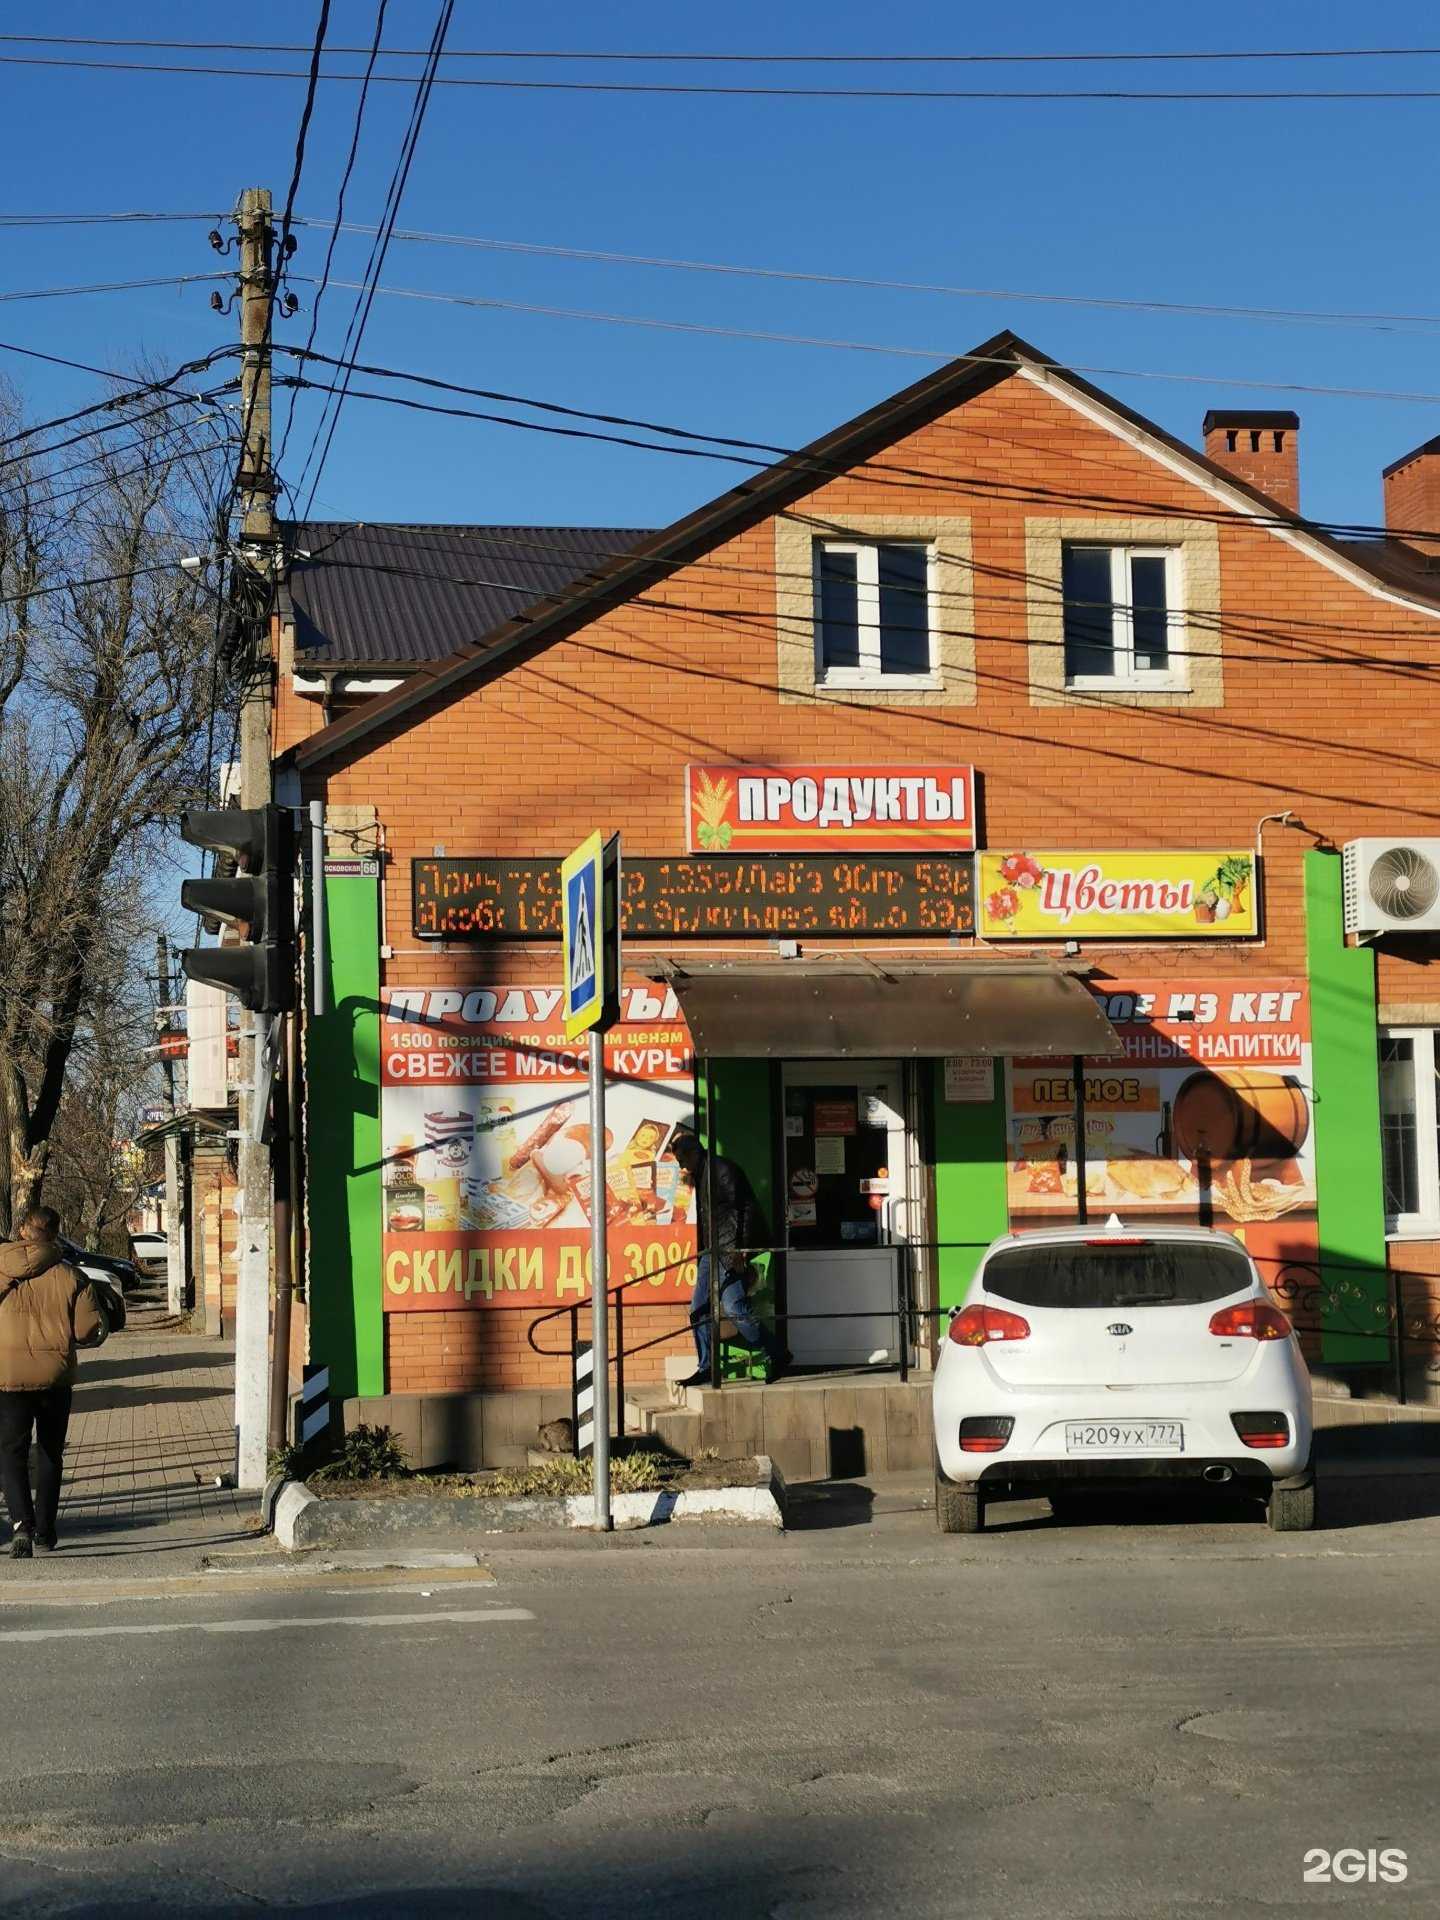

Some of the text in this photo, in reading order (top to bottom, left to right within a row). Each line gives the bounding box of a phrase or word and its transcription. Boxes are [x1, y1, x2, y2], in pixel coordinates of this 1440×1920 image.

[737, 777, 965, 828] ПРОДУКТЫ
[1043, 868, 1193, 917] Цветы
[386, 988, 680, 1023] ПРОДУЫ
[1167, 992, 1220, 1024] ИЗ
[1229, 991, 1302, 1024] КЕГ
[390, 1032, 433, 1048] 1500
[438, 1031, 514, 1050] позиций
[520, 1034, 541, 1047] по
[627, 1031, 684, 1047] ценам
[1198, 1033, 1301, 1058] НАПИТКИ
[387, 1051, 508, 1078] СВЕЖЕЕ
[612, 1047, 690, 1075] КУРЫ
[386, 1246, 544, 1300] СКИДКИ
[622, 1240, 698, 1288] 30%
[1073, 1425, 1176, 1445] Н209УХ 777
